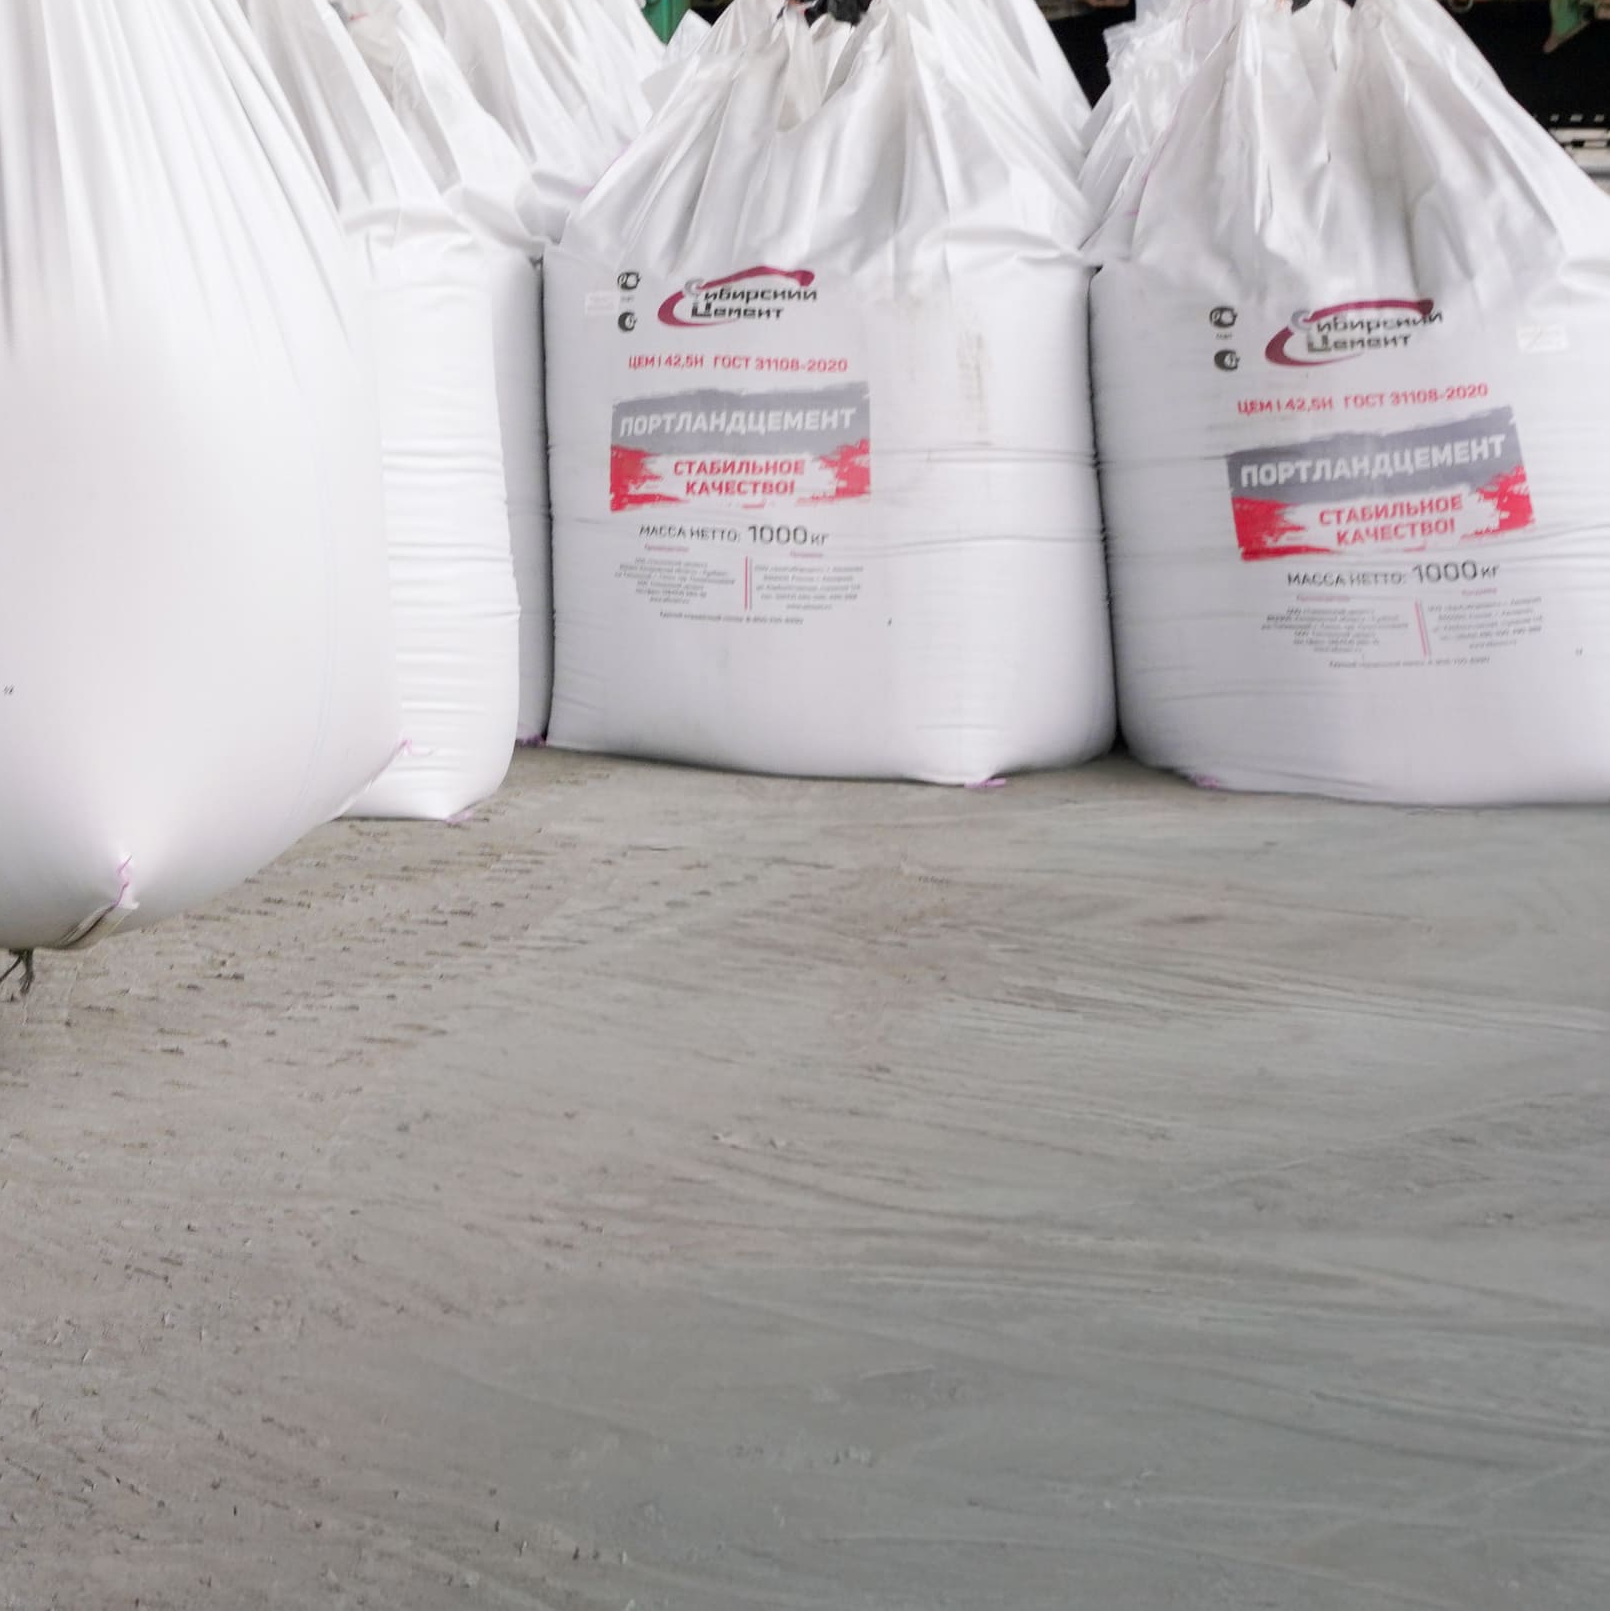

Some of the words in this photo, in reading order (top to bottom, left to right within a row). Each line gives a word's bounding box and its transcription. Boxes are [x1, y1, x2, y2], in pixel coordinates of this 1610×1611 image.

[691, 301, 784, 319] Цемент
[1307, 333, 1412, 354] Цемент
[713, 355, 751, 370] ГОСТ
[1343, 392, 1385, 410] ГОСТ
[619, 407, 857, 438] ПОРТЛАНДЦЕМЕНТ
[673, 458, 806, 477] СТАБИЛЬНОЕ
[1241, 434, 1507, 488] ПОРТЛАНДЦЕМЕНТ
[685, 480, 796, 497] КАЧЕСТВО!
[1319, 493, 1464, 527] СТАБИЛЬНОЕ
[639, 523, 688, 540] МАССА
[747, 524, 809, 546] 1000
[1336, 518, 1456, 547] КАЧЕСТВО!
[1287, 569, 1351, 588] МАССА
[1411, 559, 1478, 584] 1000
